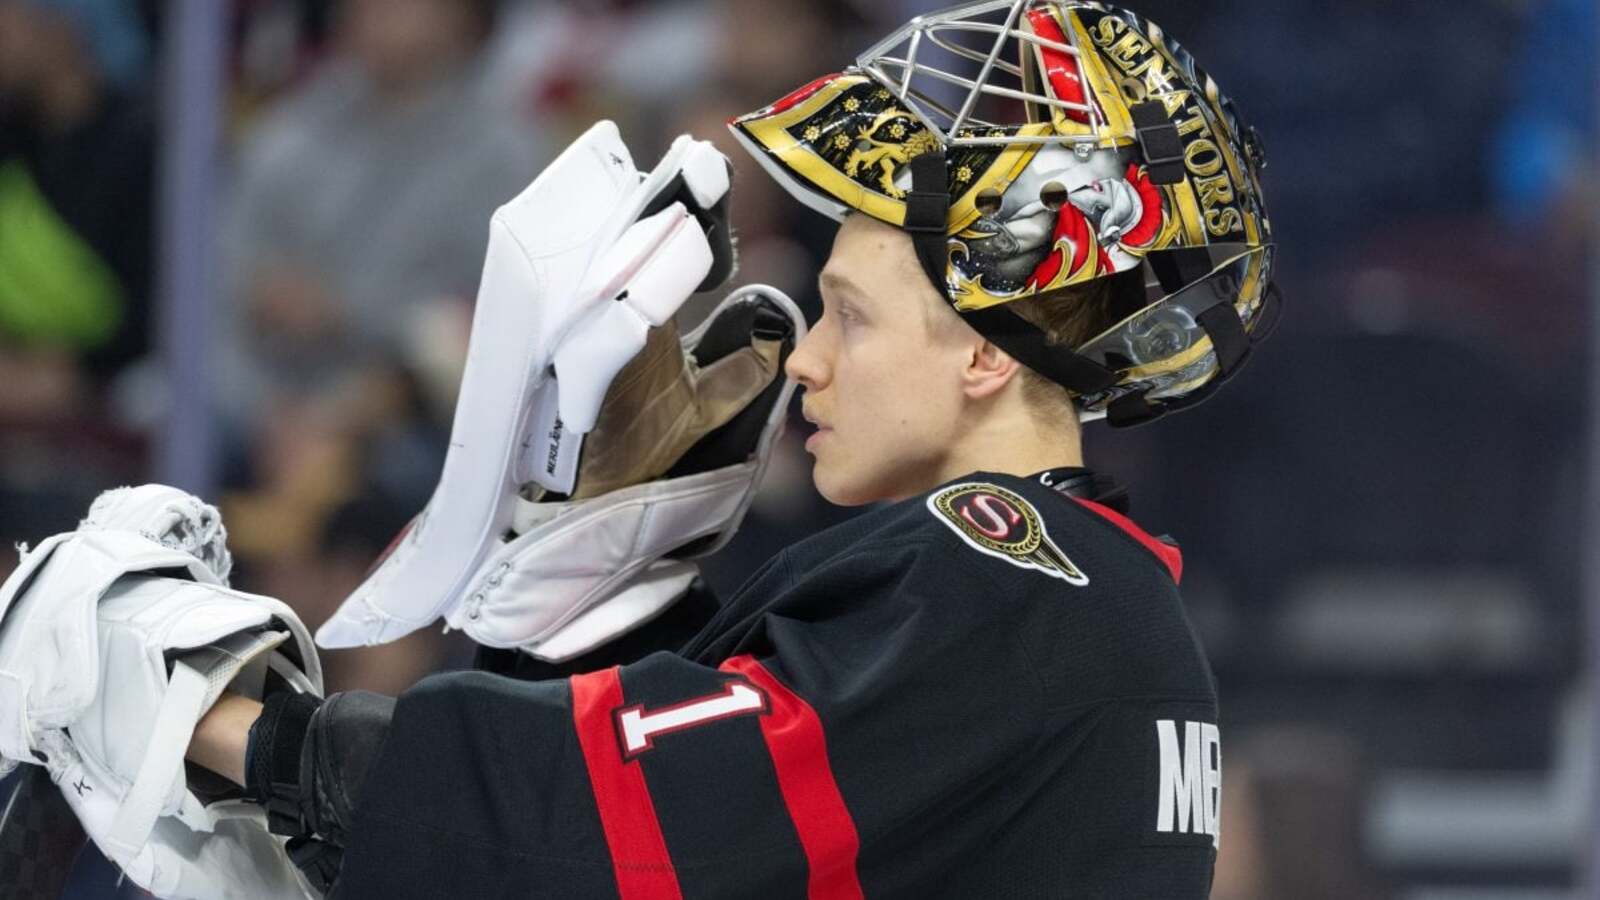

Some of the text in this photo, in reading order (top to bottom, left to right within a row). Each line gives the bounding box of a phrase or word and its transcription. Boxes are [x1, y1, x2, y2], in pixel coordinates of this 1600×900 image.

[1088, 15, 1243, 237] SENATORS
[959, 493, 1022, 540] S
[617, 682, 766, 757] 1
